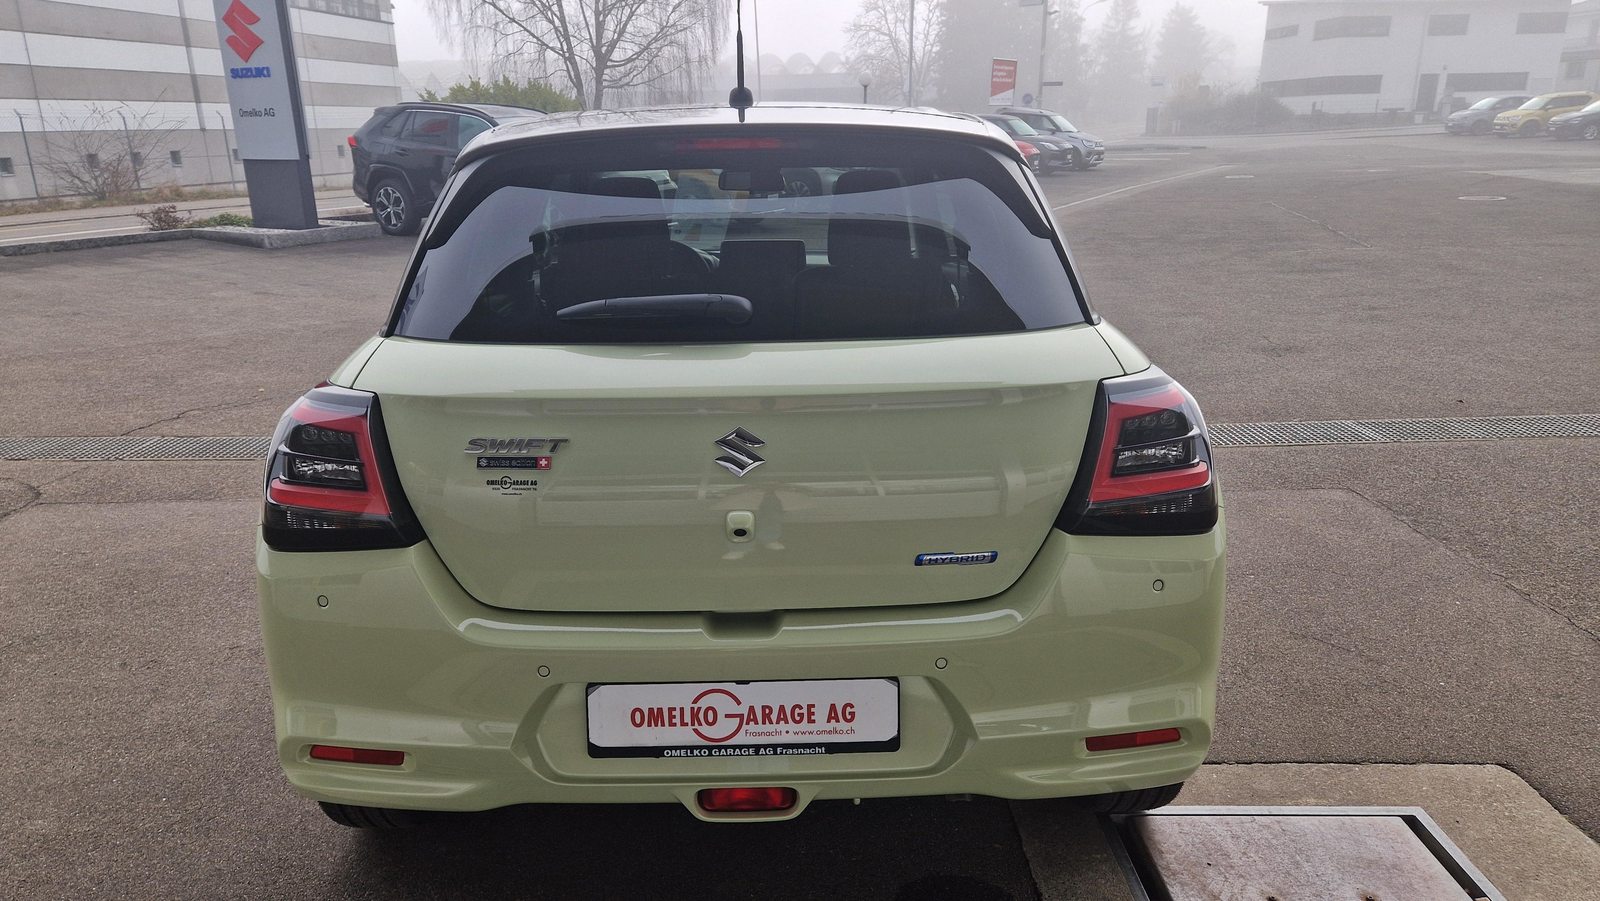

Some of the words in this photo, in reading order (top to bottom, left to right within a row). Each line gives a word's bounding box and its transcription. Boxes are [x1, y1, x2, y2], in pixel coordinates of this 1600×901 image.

[230, 67, 271, 79] SUZUKI
[239, 108, 263, 117] Omelko
[263, 107, 276, 117] AG
[464, 438, 569, 454] SWIFT
[486, 479, 508, 487] OMELKO
[928, 554, 986, 565] HYBRID
[630, 705, 718, 728] OMELKO
[826, 703, 856, 724] AG
[744, 729, 783, 737] Frasnacht
[792, 726, 856, 736] www.omelko.ch
[664, 749, 709, 757] OMELKO
[711, 748, 756, 756] GARAGE
[776, 746, 826, 755] Frasnacht
